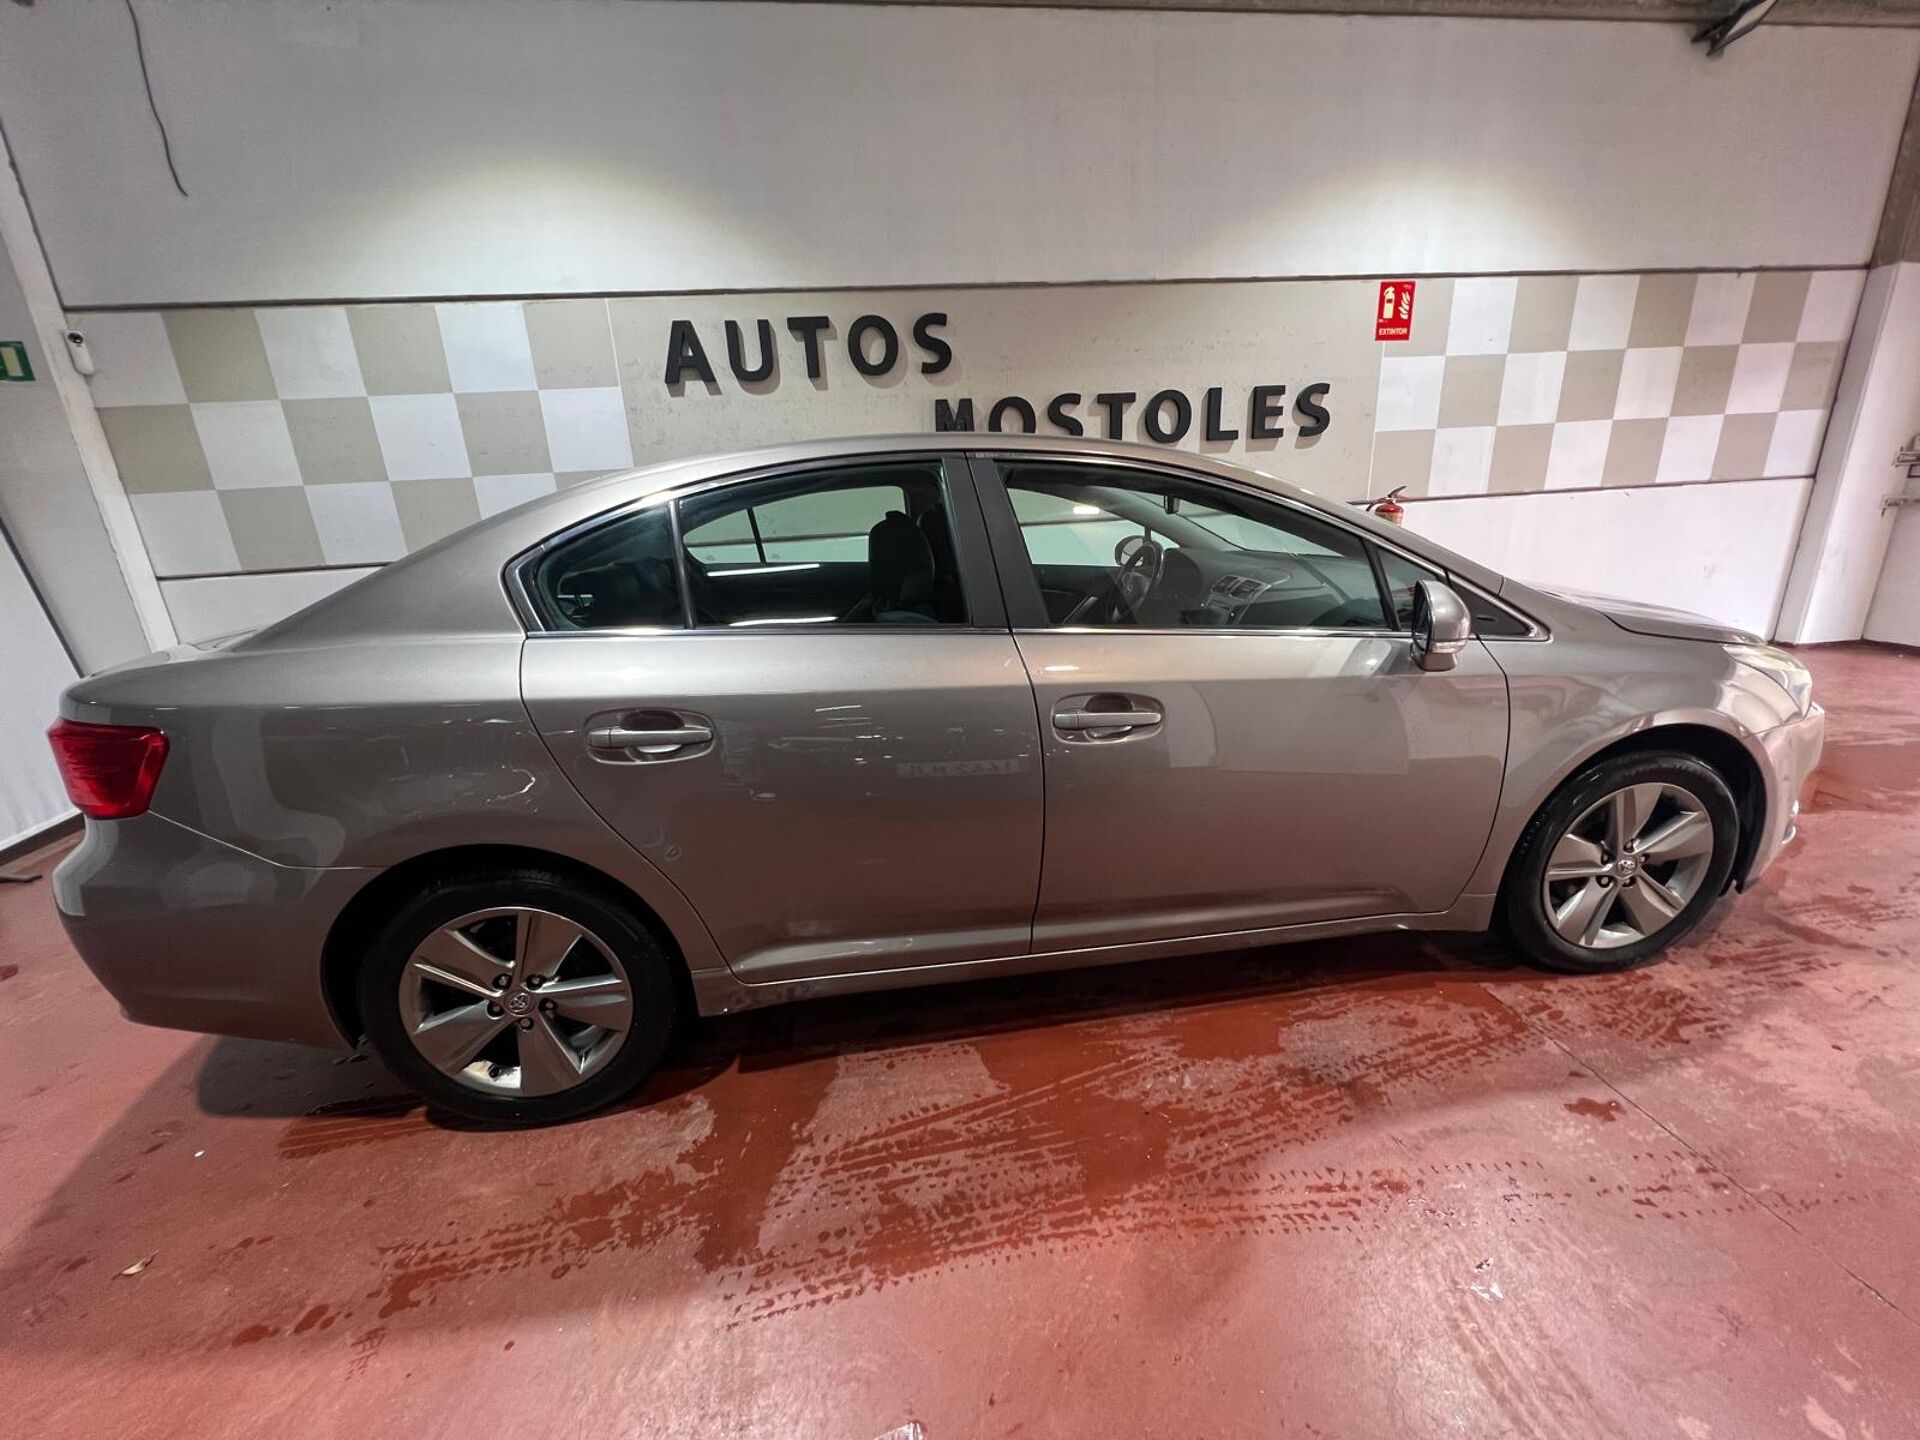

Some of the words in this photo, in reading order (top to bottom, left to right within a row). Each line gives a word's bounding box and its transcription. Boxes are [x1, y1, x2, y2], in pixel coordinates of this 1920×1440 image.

[664, 312, 953, 385] AUTOS
[1378, 327, 1408, 336] EXTINTOR
[934, 382, 1332, 444] MOSTOLES
